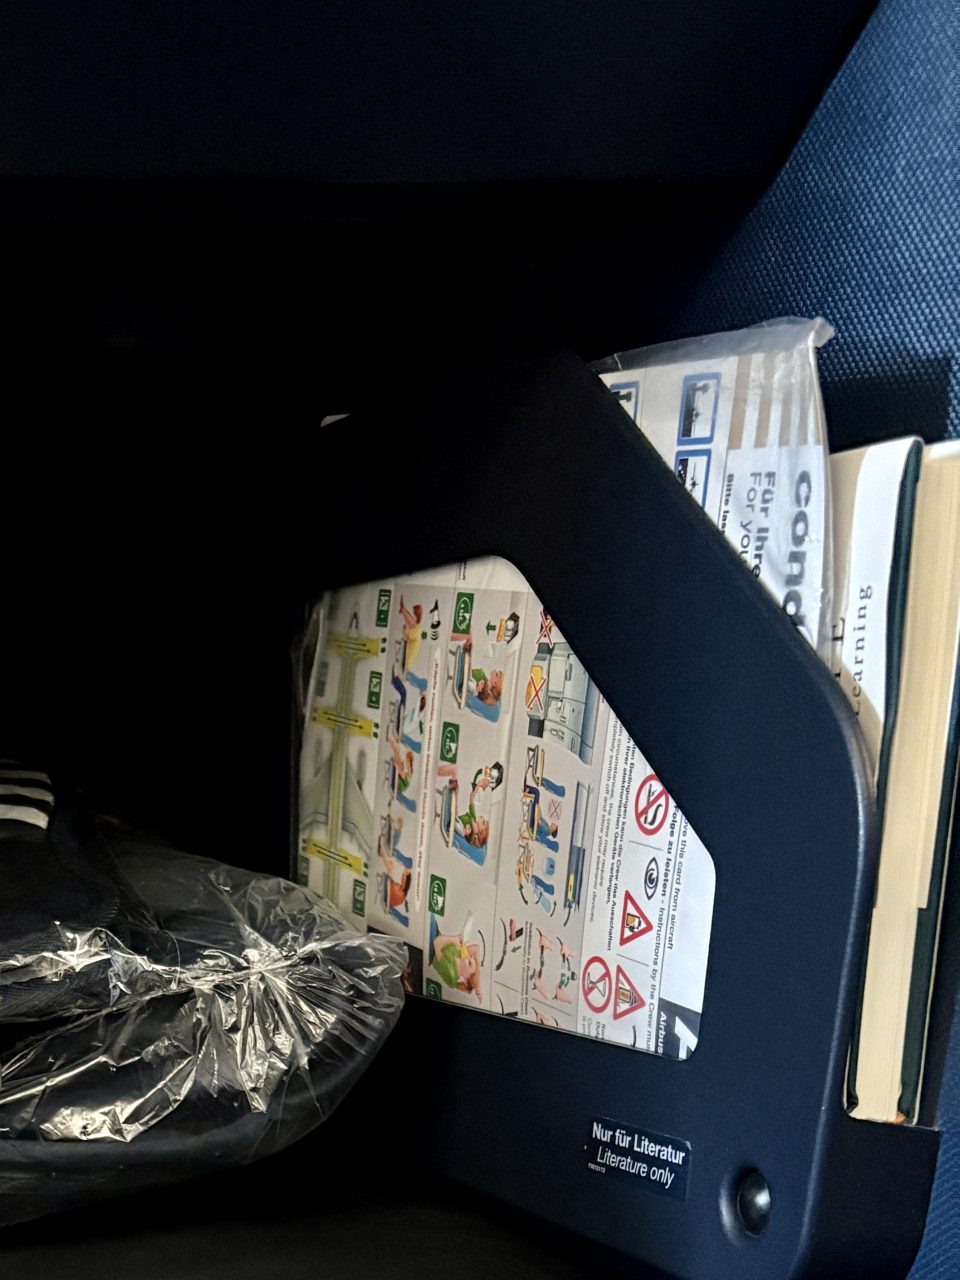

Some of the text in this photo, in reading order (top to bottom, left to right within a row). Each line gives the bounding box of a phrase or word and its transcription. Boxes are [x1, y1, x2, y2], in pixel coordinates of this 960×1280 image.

[744, 471, 762, 513] For
[750, 470, 776, 578] Für Ihre
[667, 840, 673, 854] zu
[678, 839, 687, 858] this
[661, 857, 671, 896] leisten
[675, 861, 684, 884] card
[671, 887, 680, 911] from
[652, 907, 666, 965] Instructions
[667, 914, 676, 949] aircraft
[649, 968, 657, 981] by
[646, 1001, 655, 1028] Crew
[656, 1011, 667, 1053] Airbus
[592, 1121, 685, 1165] Nur für Literatur
[597, 1146, 648, 1177] Literature
[650, 1167, 675, 1189] only
